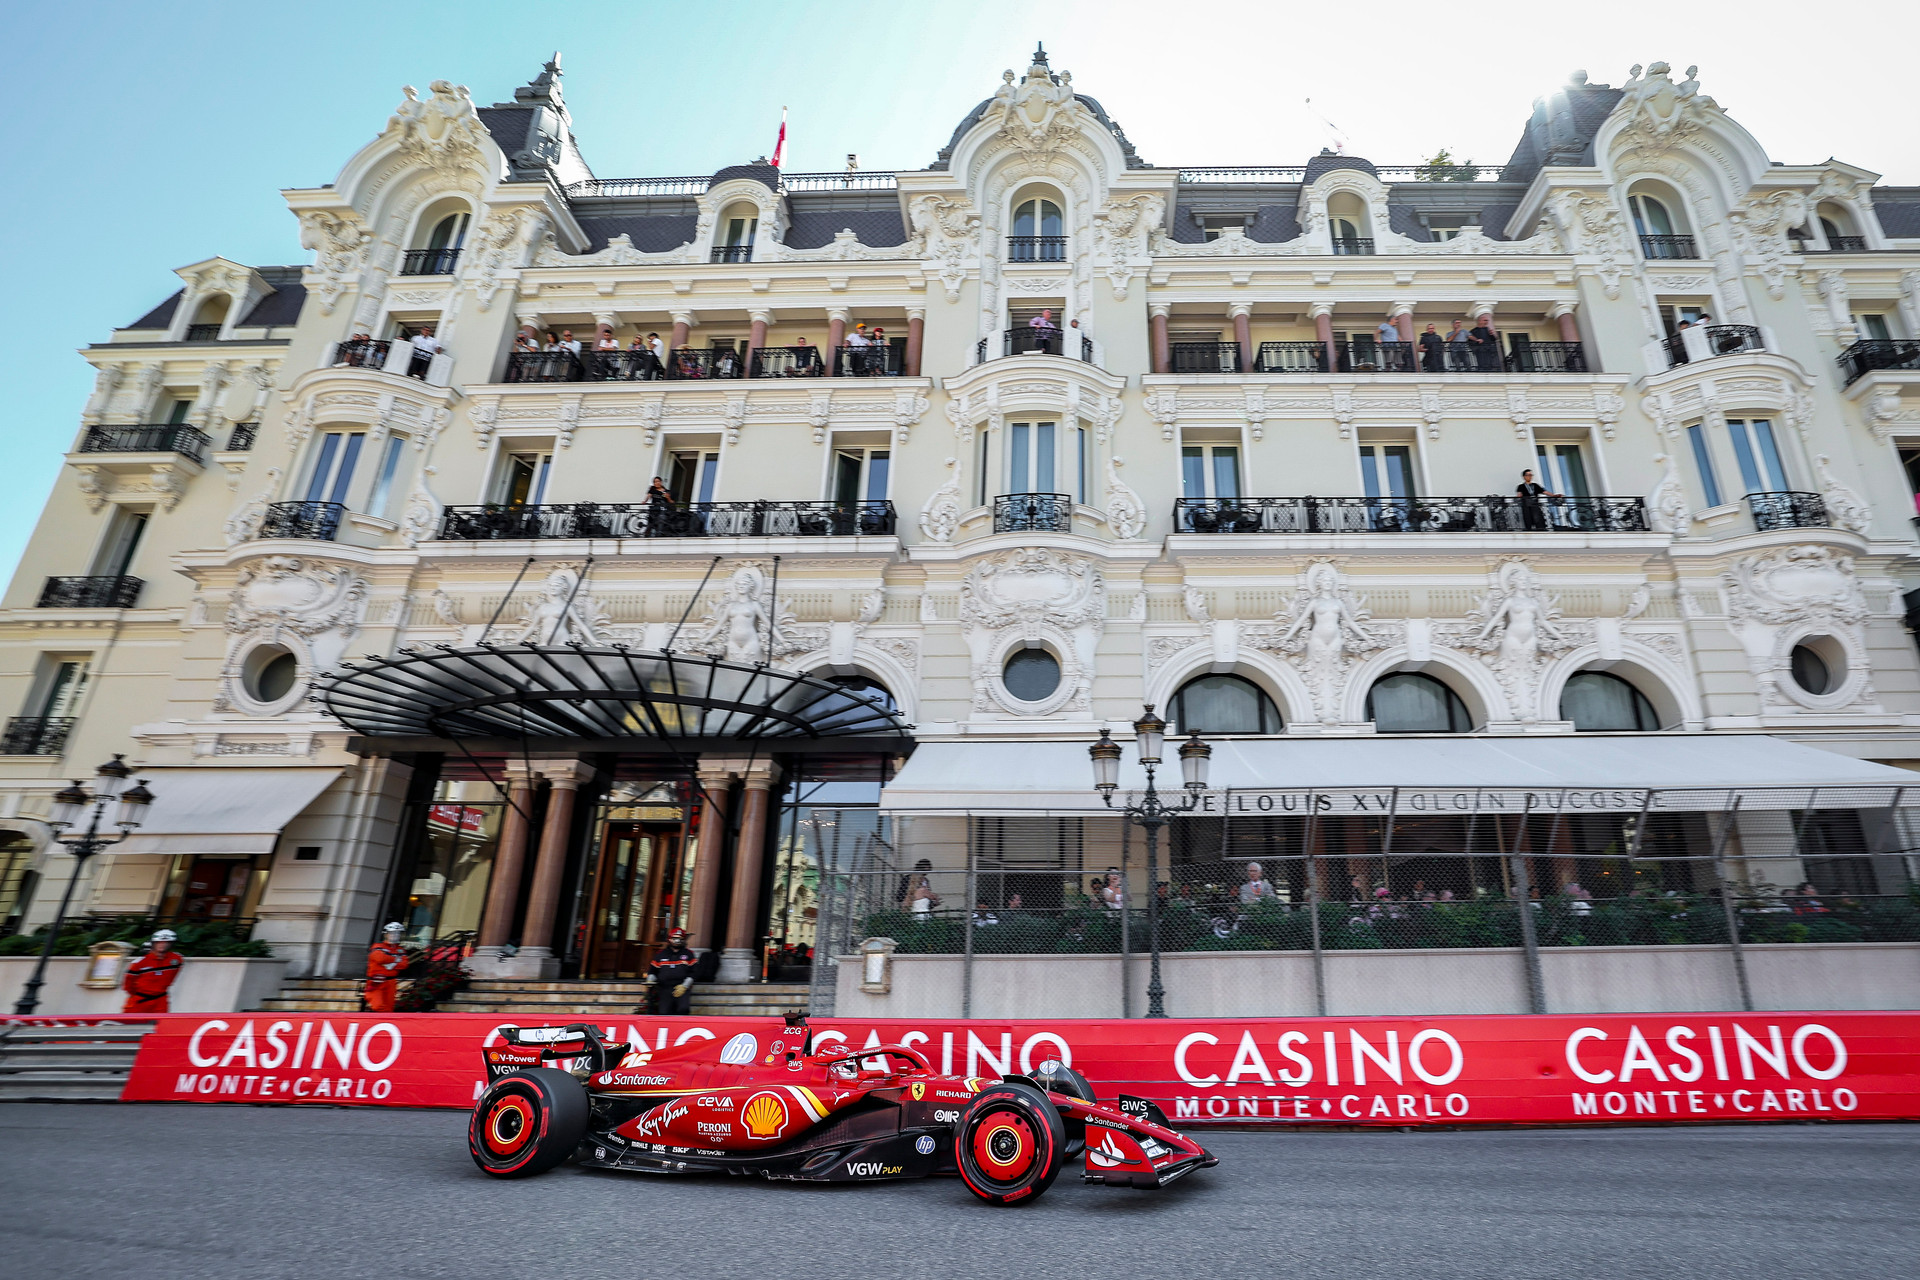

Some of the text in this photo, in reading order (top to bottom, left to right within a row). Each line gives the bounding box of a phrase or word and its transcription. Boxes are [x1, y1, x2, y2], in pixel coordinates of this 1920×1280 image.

[1238, 794, 1332, 812] LOUIS
[1352, 794, 1391, 811] XV
[188, 1019, 402, 1072] CASINO
[723, 1033, 754, 1063] hp
[500, 1054, 536, 1063] V-Power
[1174, 1028, 1463, 1088] CASINO
[1565, 1022, 1848, 1085] CASINO
[174, 1074, 393, 1100] MONTE CARLO
[613, 1073, 671, 1086] Santander
[936, 1090, 971, 1099] RICHARD
[1571, 1087, 1859, 1115] MONTE CARLO
[1121, 1100, 1147, 1112] aws
[1175, 1093, 1470, 1118] MONTE CARLO
[697, 1121, 732, 1133] PERONI
[1094, 1116, 1130, 1131] Santander
[607, 1132, 625, 1145] brembo
[631, 1141, 648, 1149] MAHLE
[917, 1136, 934, 1154] hp
[652, 1143, 666, 1151] NGK
[846, 1162, 903, 1176] VGW PLAY
